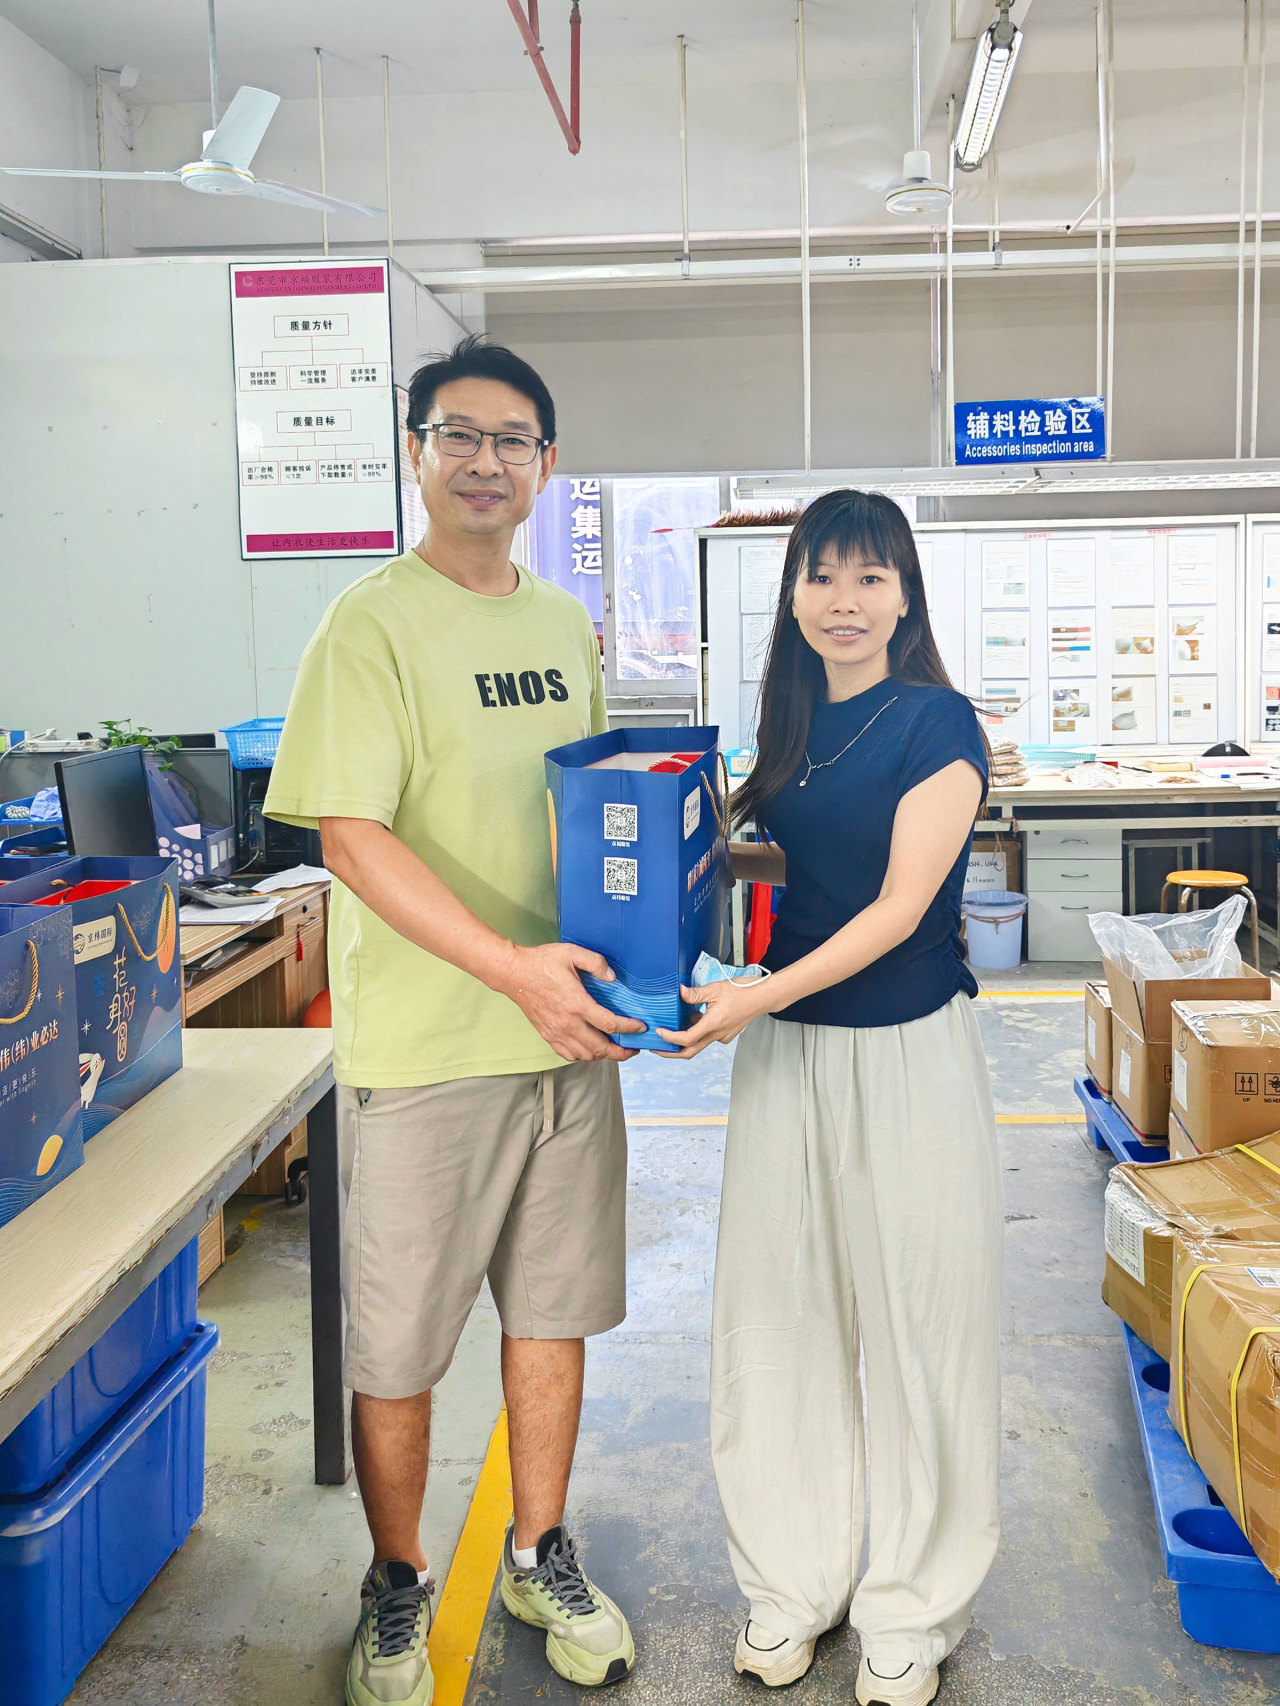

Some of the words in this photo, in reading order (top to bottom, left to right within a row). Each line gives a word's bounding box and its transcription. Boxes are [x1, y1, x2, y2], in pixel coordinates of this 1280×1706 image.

[290, 319, 333, 331] 质量方针
[300, 369, 327, 377] 科学管理
[350, 375, 377, 383] 客户满意
[293, 415, 336, 427] 质量目标
[966, 408, 1093, 440] 辅料检验区
[965, 442, 1020, 458] Accessories
[1022, 440, 1072, 457] inspection
[1073, 441, 1094, 453] area
[474, 668, 569, 708] ENOS
